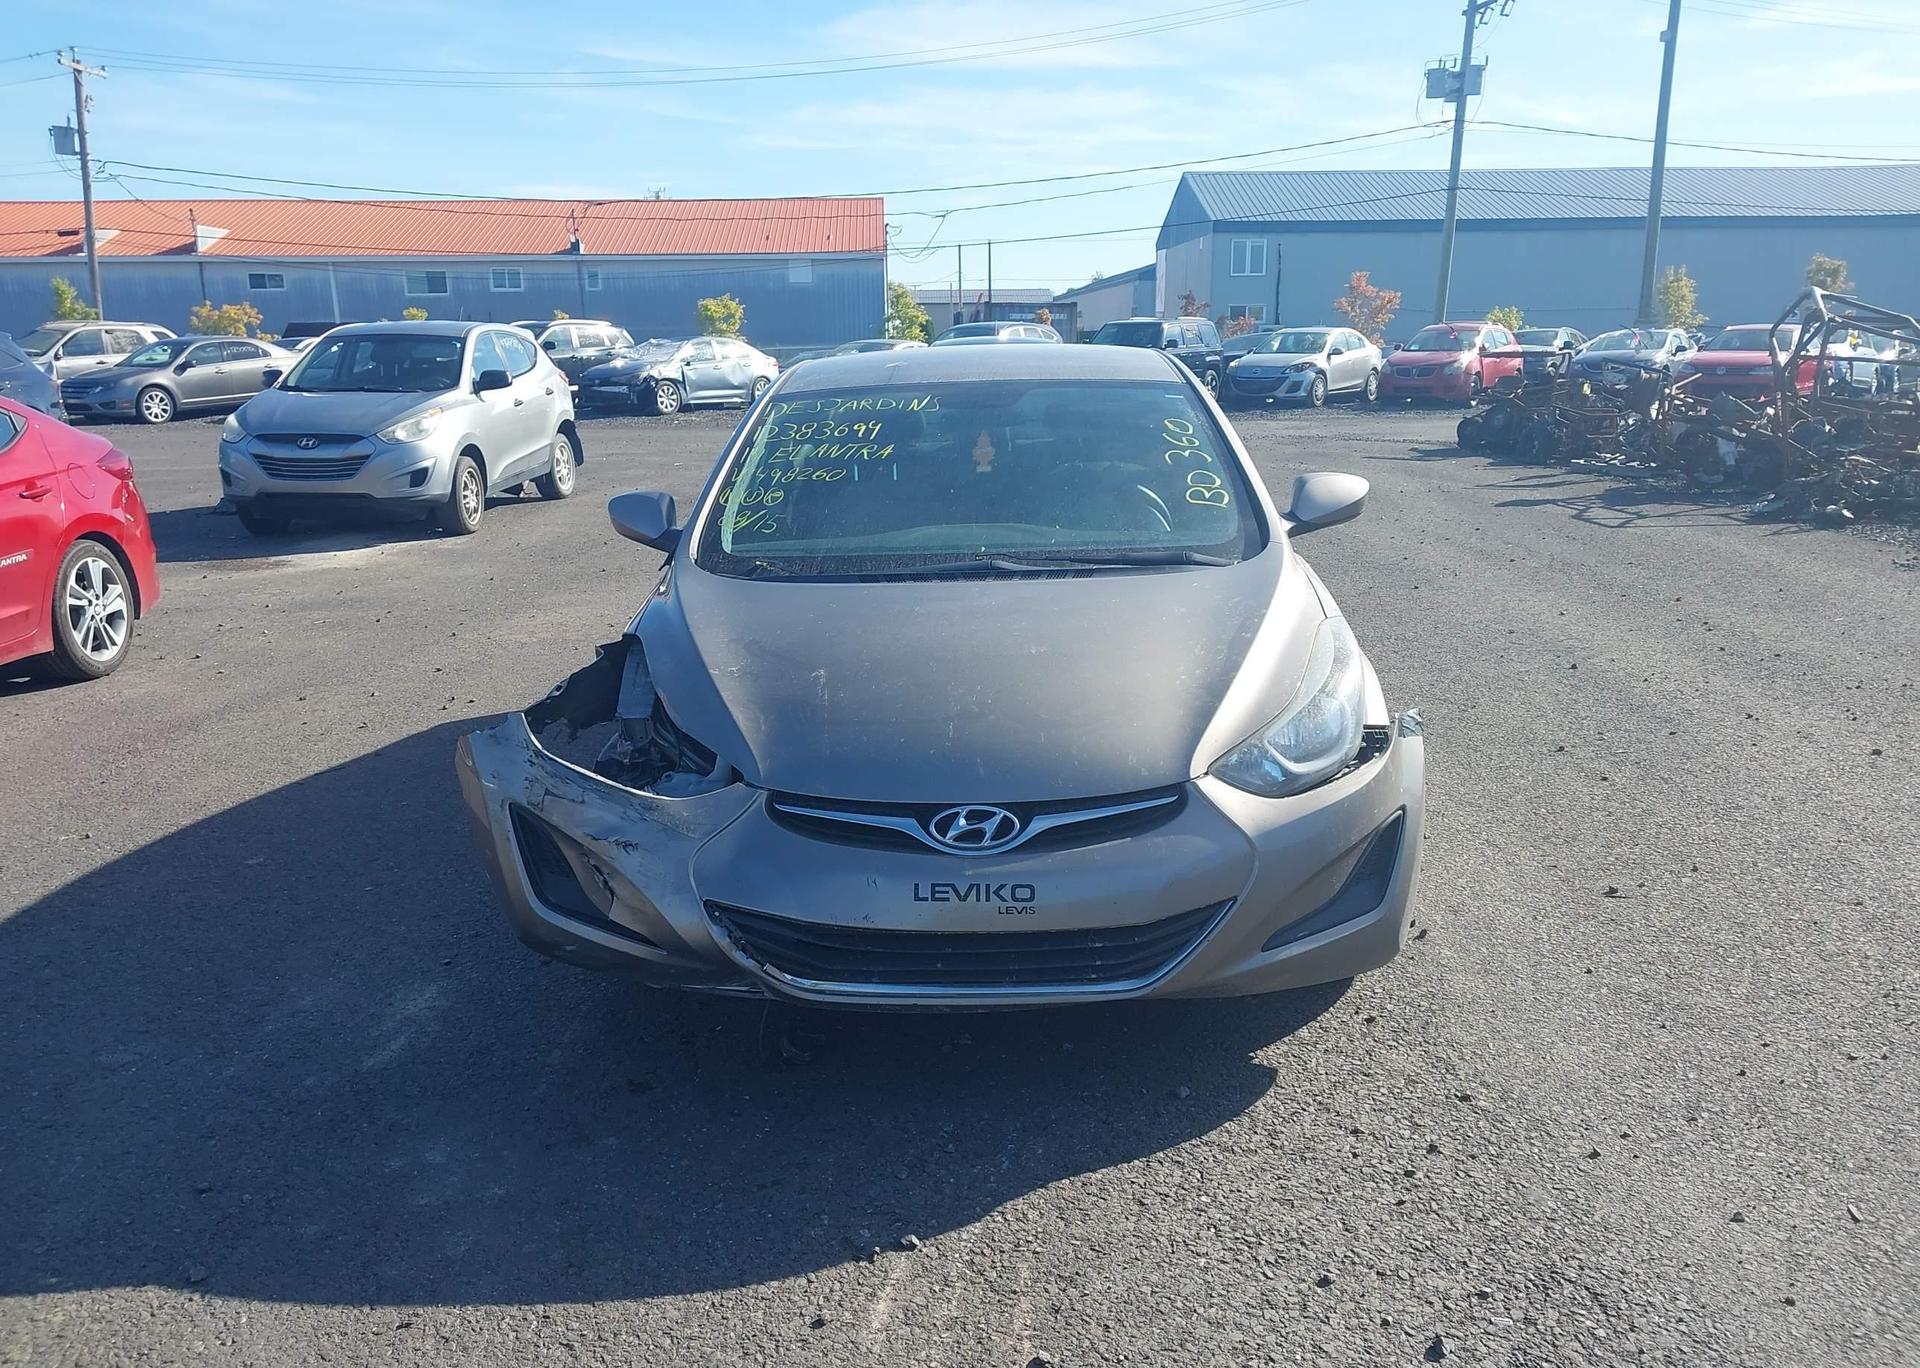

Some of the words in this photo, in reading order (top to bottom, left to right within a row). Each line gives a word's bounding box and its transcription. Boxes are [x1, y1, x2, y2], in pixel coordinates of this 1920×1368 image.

[762, 394, 944, 419] DESJARDINS
[1162, 418, 1213, 465] 360
[768, 443, 895, 464] ELANTRA
[0, 554, 28, 568] ANTRA
[913, 882, 1036, 903] LEVIKO
[998, 906, 1036, 915] LEVIS
